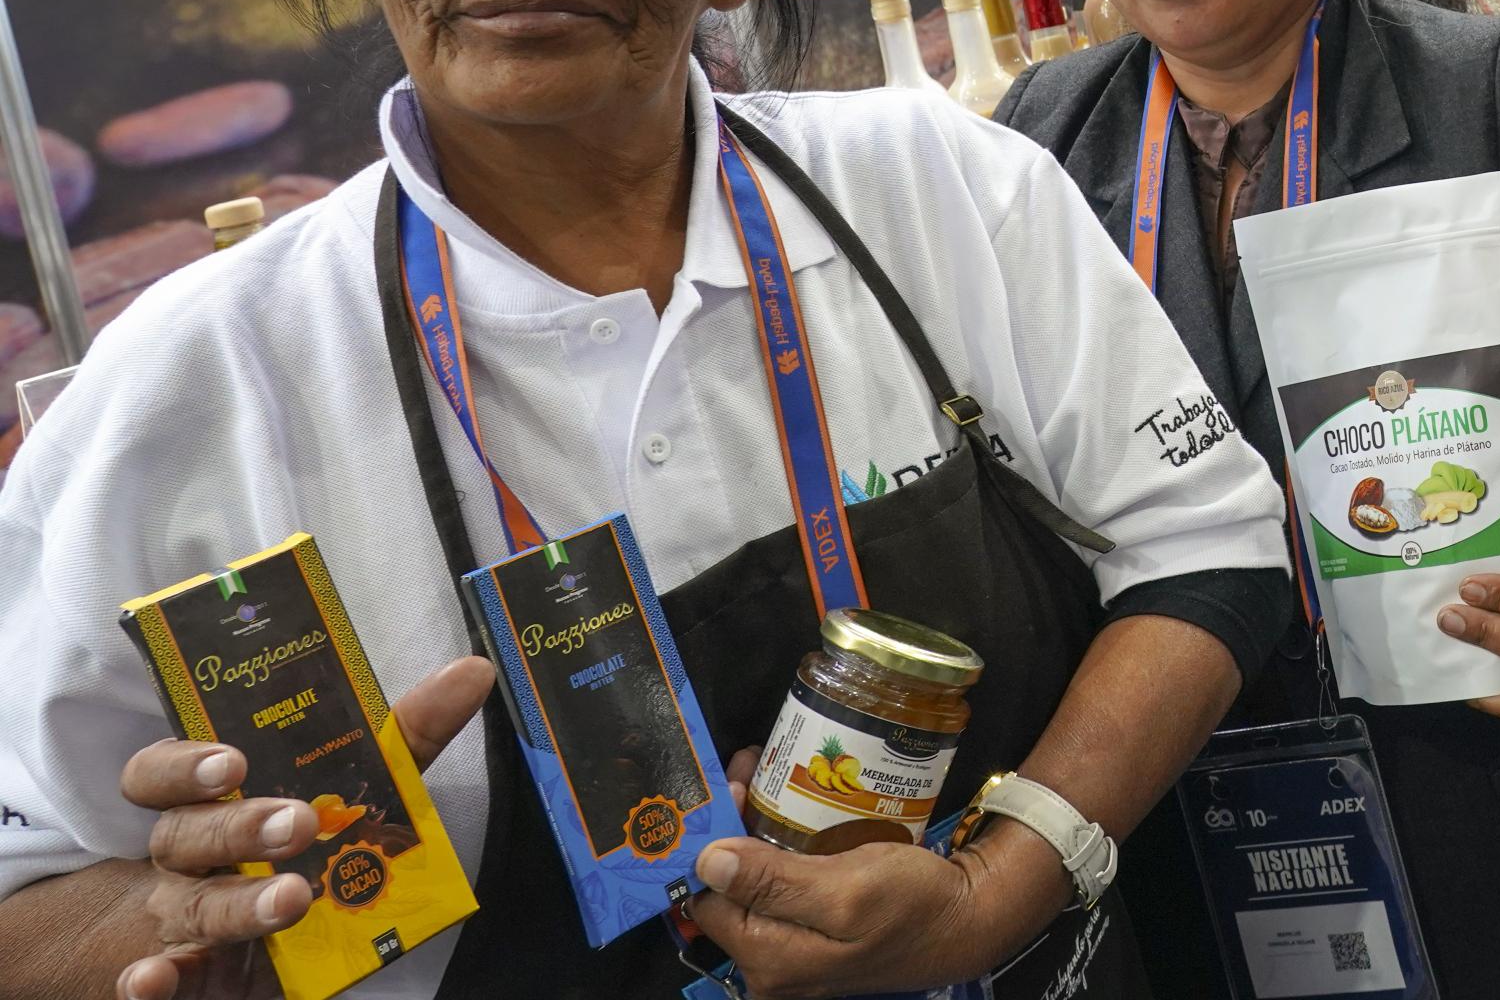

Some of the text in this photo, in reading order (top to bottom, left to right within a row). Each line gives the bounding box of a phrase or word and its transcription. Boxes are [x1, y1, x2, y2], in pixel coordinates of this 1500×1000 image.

[1323, 404, 1489, 458] CHOCO PLÁTANO
[1330, 462, 1349, 475] Cacao
[1376, 451, 1404, 466] Molido
[1405, 454, 1411, 466] y
[1413, 447, 1441, 461] Harina
[1443, 443, 1455, 456] de
[1457, 439, 1492, 453] Plátano
[521, 602, 635, 657] Pazziones
[195, 630, 327, 692] Pazziones
[569, 653, 626, 690] CHOCOLATE
[252, 688, 319, 729] CHOCOLATE
[295, 728, 365, 768] AGUAYMANTO
[860, 767, 922, 788] MERMELADA
[922, 779, 933, 788] DE
[873, 782, 919, 798] PULPA DE
[638, 810, 664, 831] 50%
[875, 796, 904, 816] PIÑA
[1246, 809, 1268, 828] 10
[1320, 797, 1366, 816] ADEX
[640, 824, 675, 849] CACAO
[338, 853, 371, 881] 60%
[1247, 844, 1349, 874] VISITANTE
[339, 869, 382, 898] CACAO
[1253, 864, 1354, 892] NACIONAL
